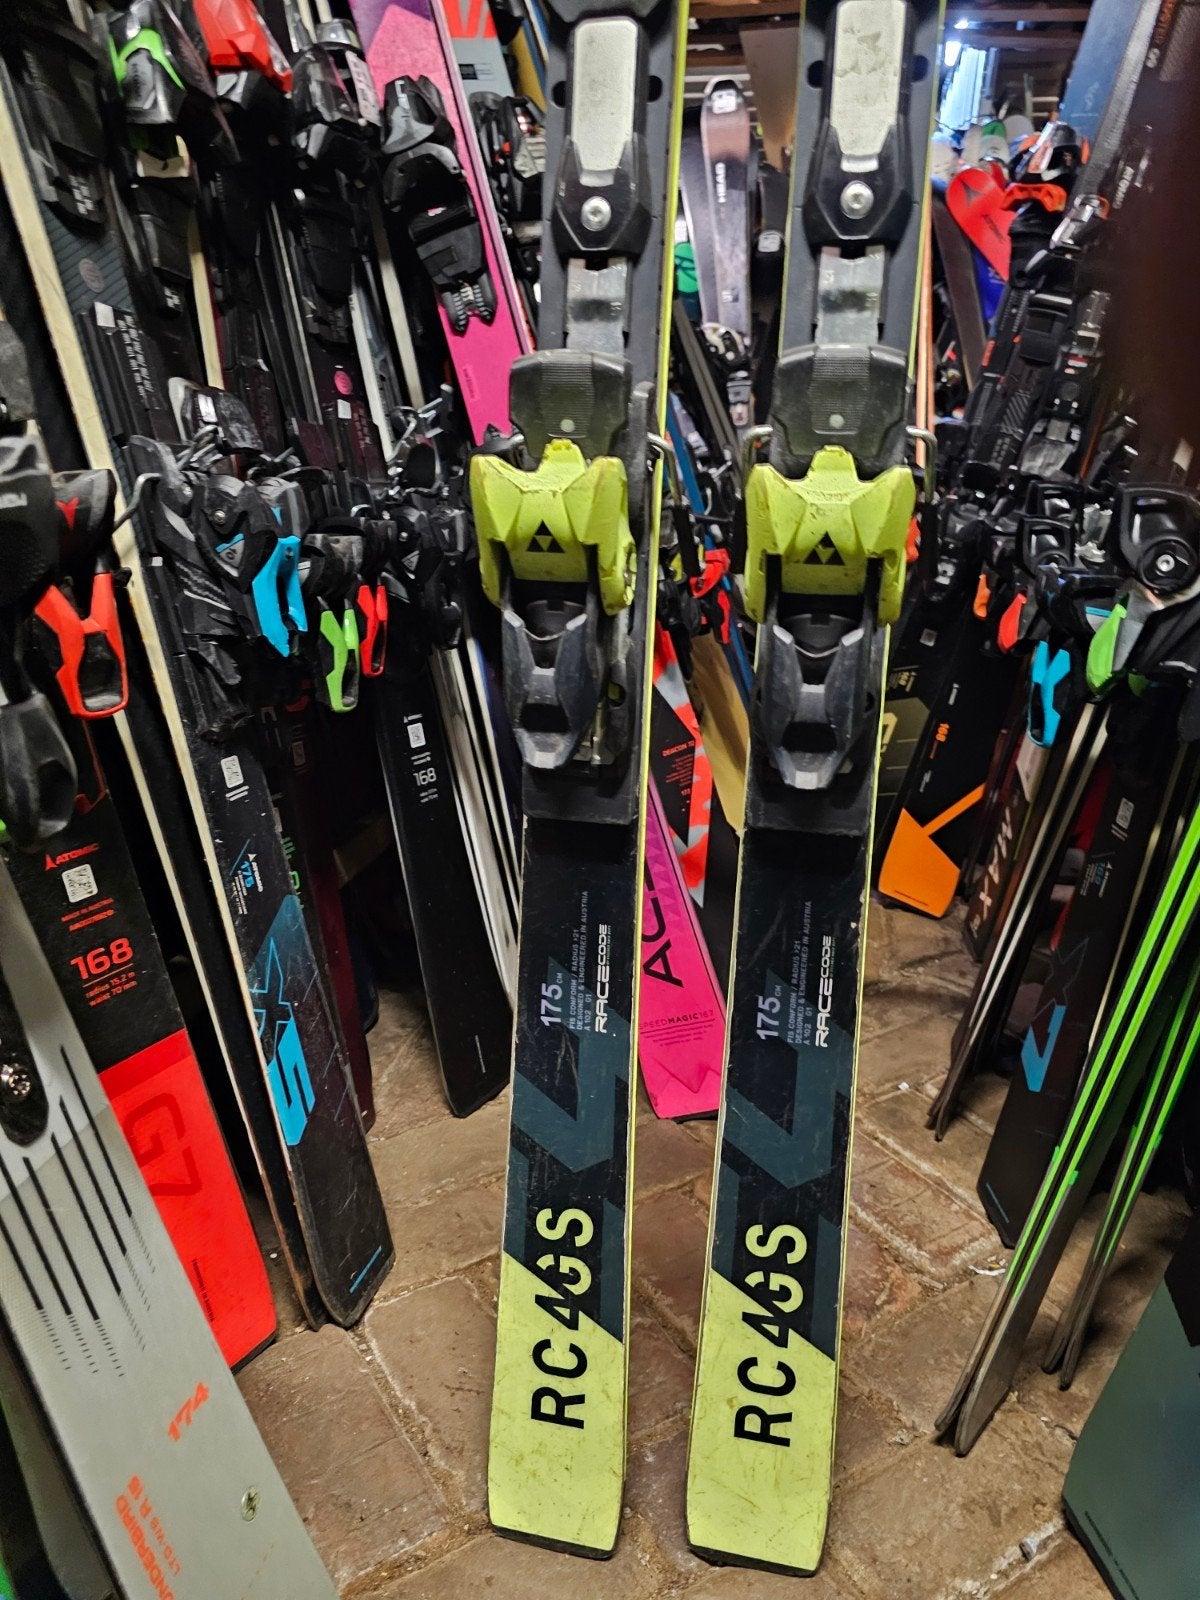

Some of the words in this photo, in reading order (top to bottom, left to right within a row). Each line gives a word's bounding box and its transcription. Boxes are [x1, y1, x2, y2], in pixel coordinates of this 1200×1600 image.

[714, 161, 727, 204] HEAD
[412, 767, 437, 787] 168
[55, 842, 100, 865] ATOMIC
[580, 890, 588, 923] AUSTRIA
[803, 901, 812, 934] AUSTRIA
[69, 937, 134, 980] 168
[571, 943, 579, 972] RADIUS
[577, 935, 587, 983] ENGINEERED
[791, 955, 800, 984] RADIUS
[798, 946, 808, 996] ENGINEERED
[110, 975, 127, 987] 15.2
[111, 987, 122, 997] 70
[594, 923, 610, 1034] RACECODE
[815, 934, 834, 1048] RACECODE
[540, 982, 563, 1028] 175
[556, 972, 564, 984] CM
[570, 979, 578, 1016] CONFORM
[576, 993, 584, 1031] DESIGNED
[755, 995, 781, 1041] 175
[775, 984, 782, 997] CM
[788, 992, 797, 1029] CONFORM
[569, 1017, 577, 1030] FIS
[584, 1010, 592, 1023] 102
[795, 1006, 804, 1044] DESIGNED
[804, 1023, 812, 1038] 102
[787, 1030, 795, 1043] FIS
